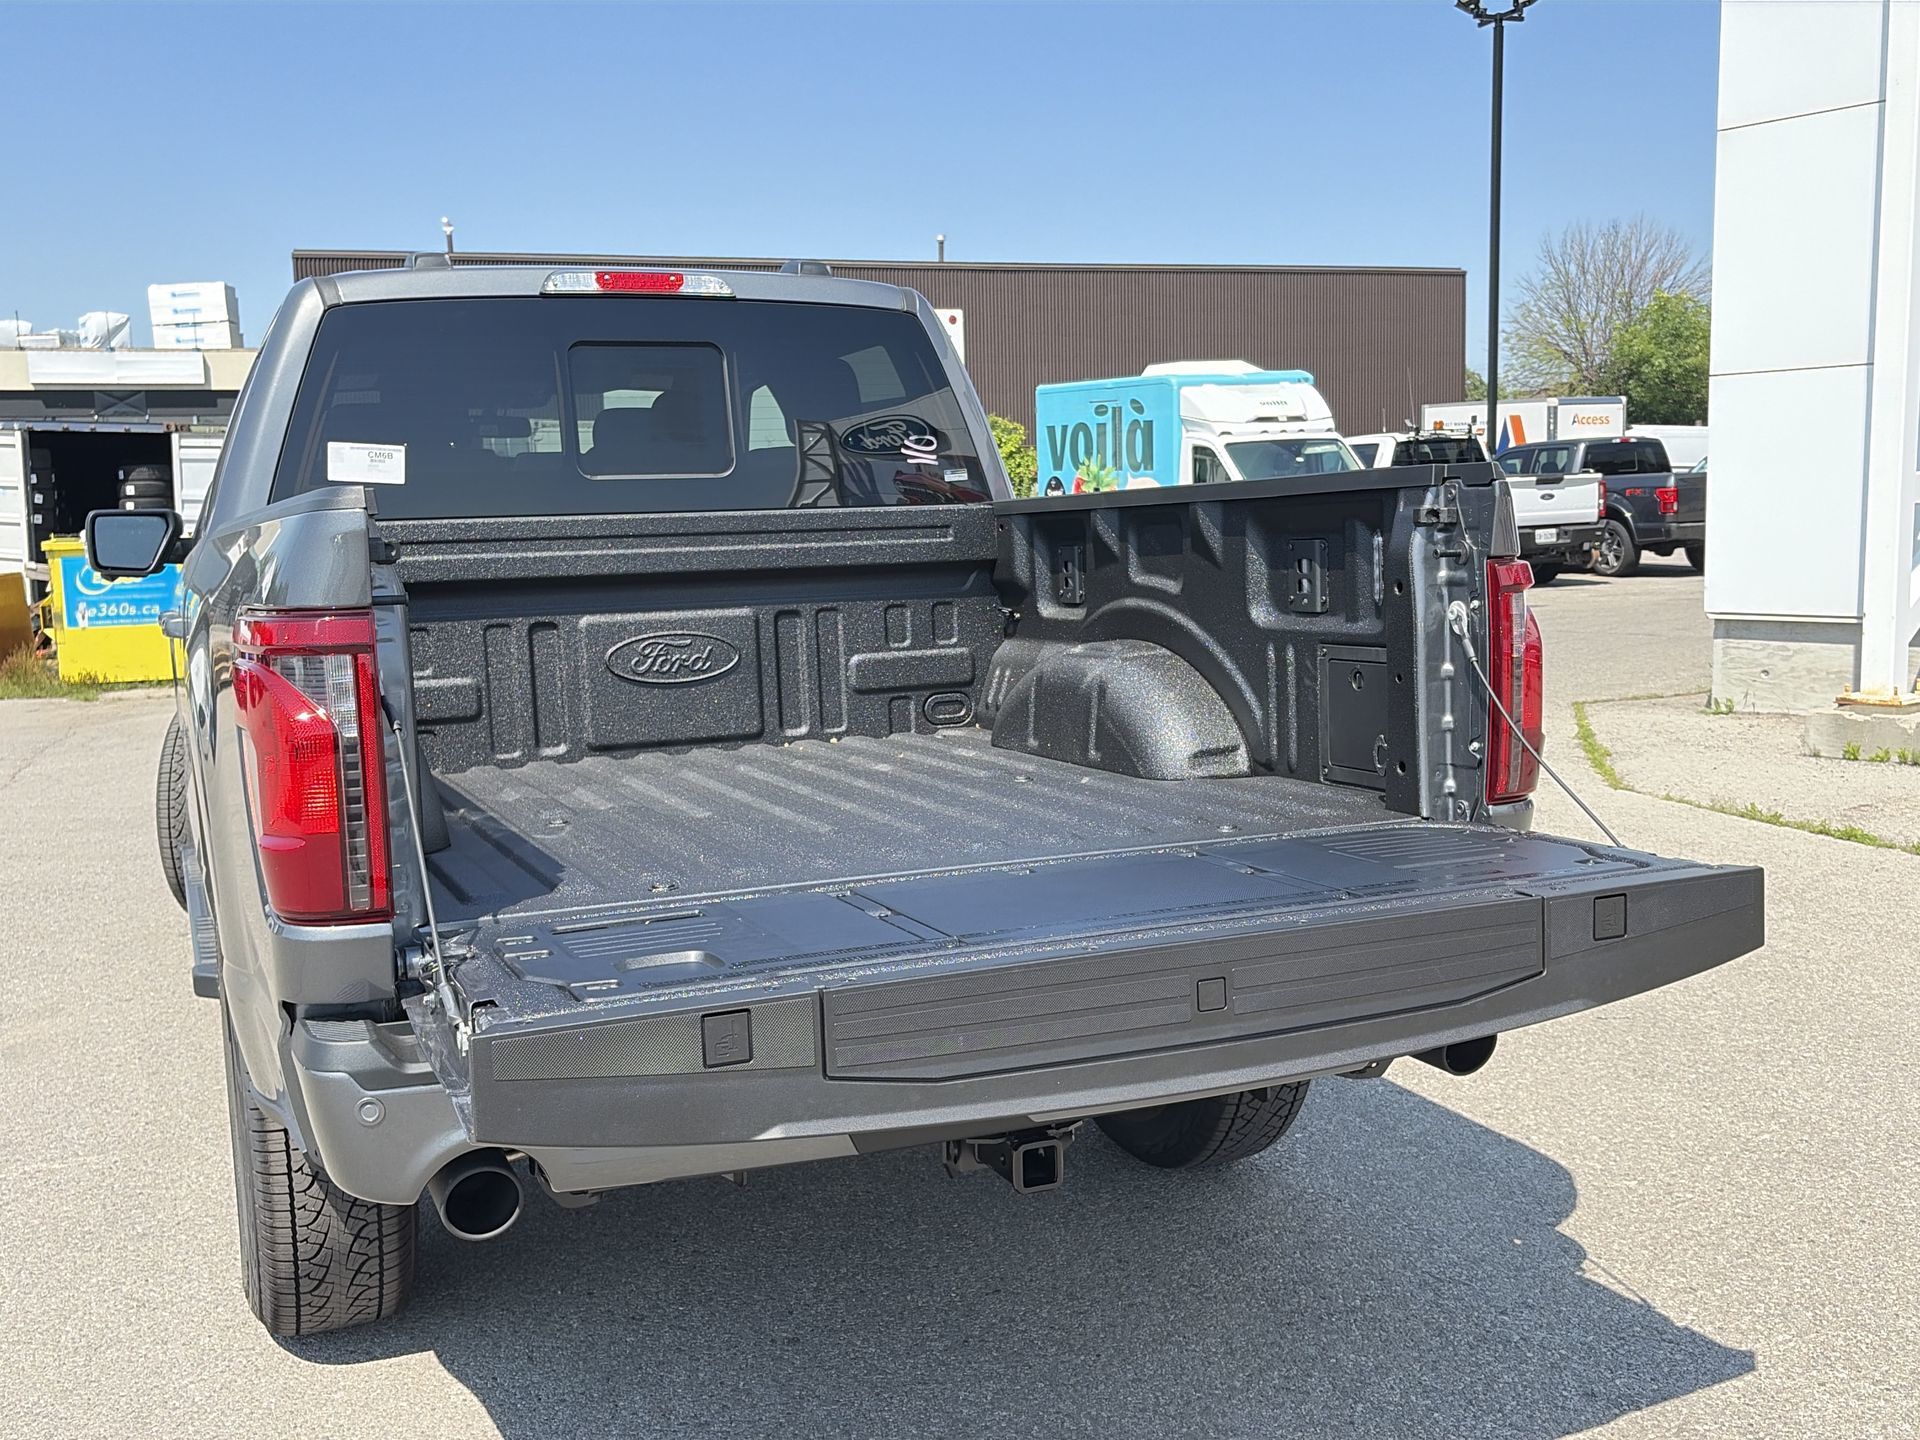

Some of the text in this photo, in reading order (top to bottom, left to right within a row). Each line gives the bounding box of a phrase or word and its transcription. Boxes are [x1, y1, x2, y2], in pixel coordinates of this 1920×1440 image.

[1046, 398, 1154, 472] voilà
[1572, 413, 1610, 426] Access
[630, 638, 714, 674] Ford
